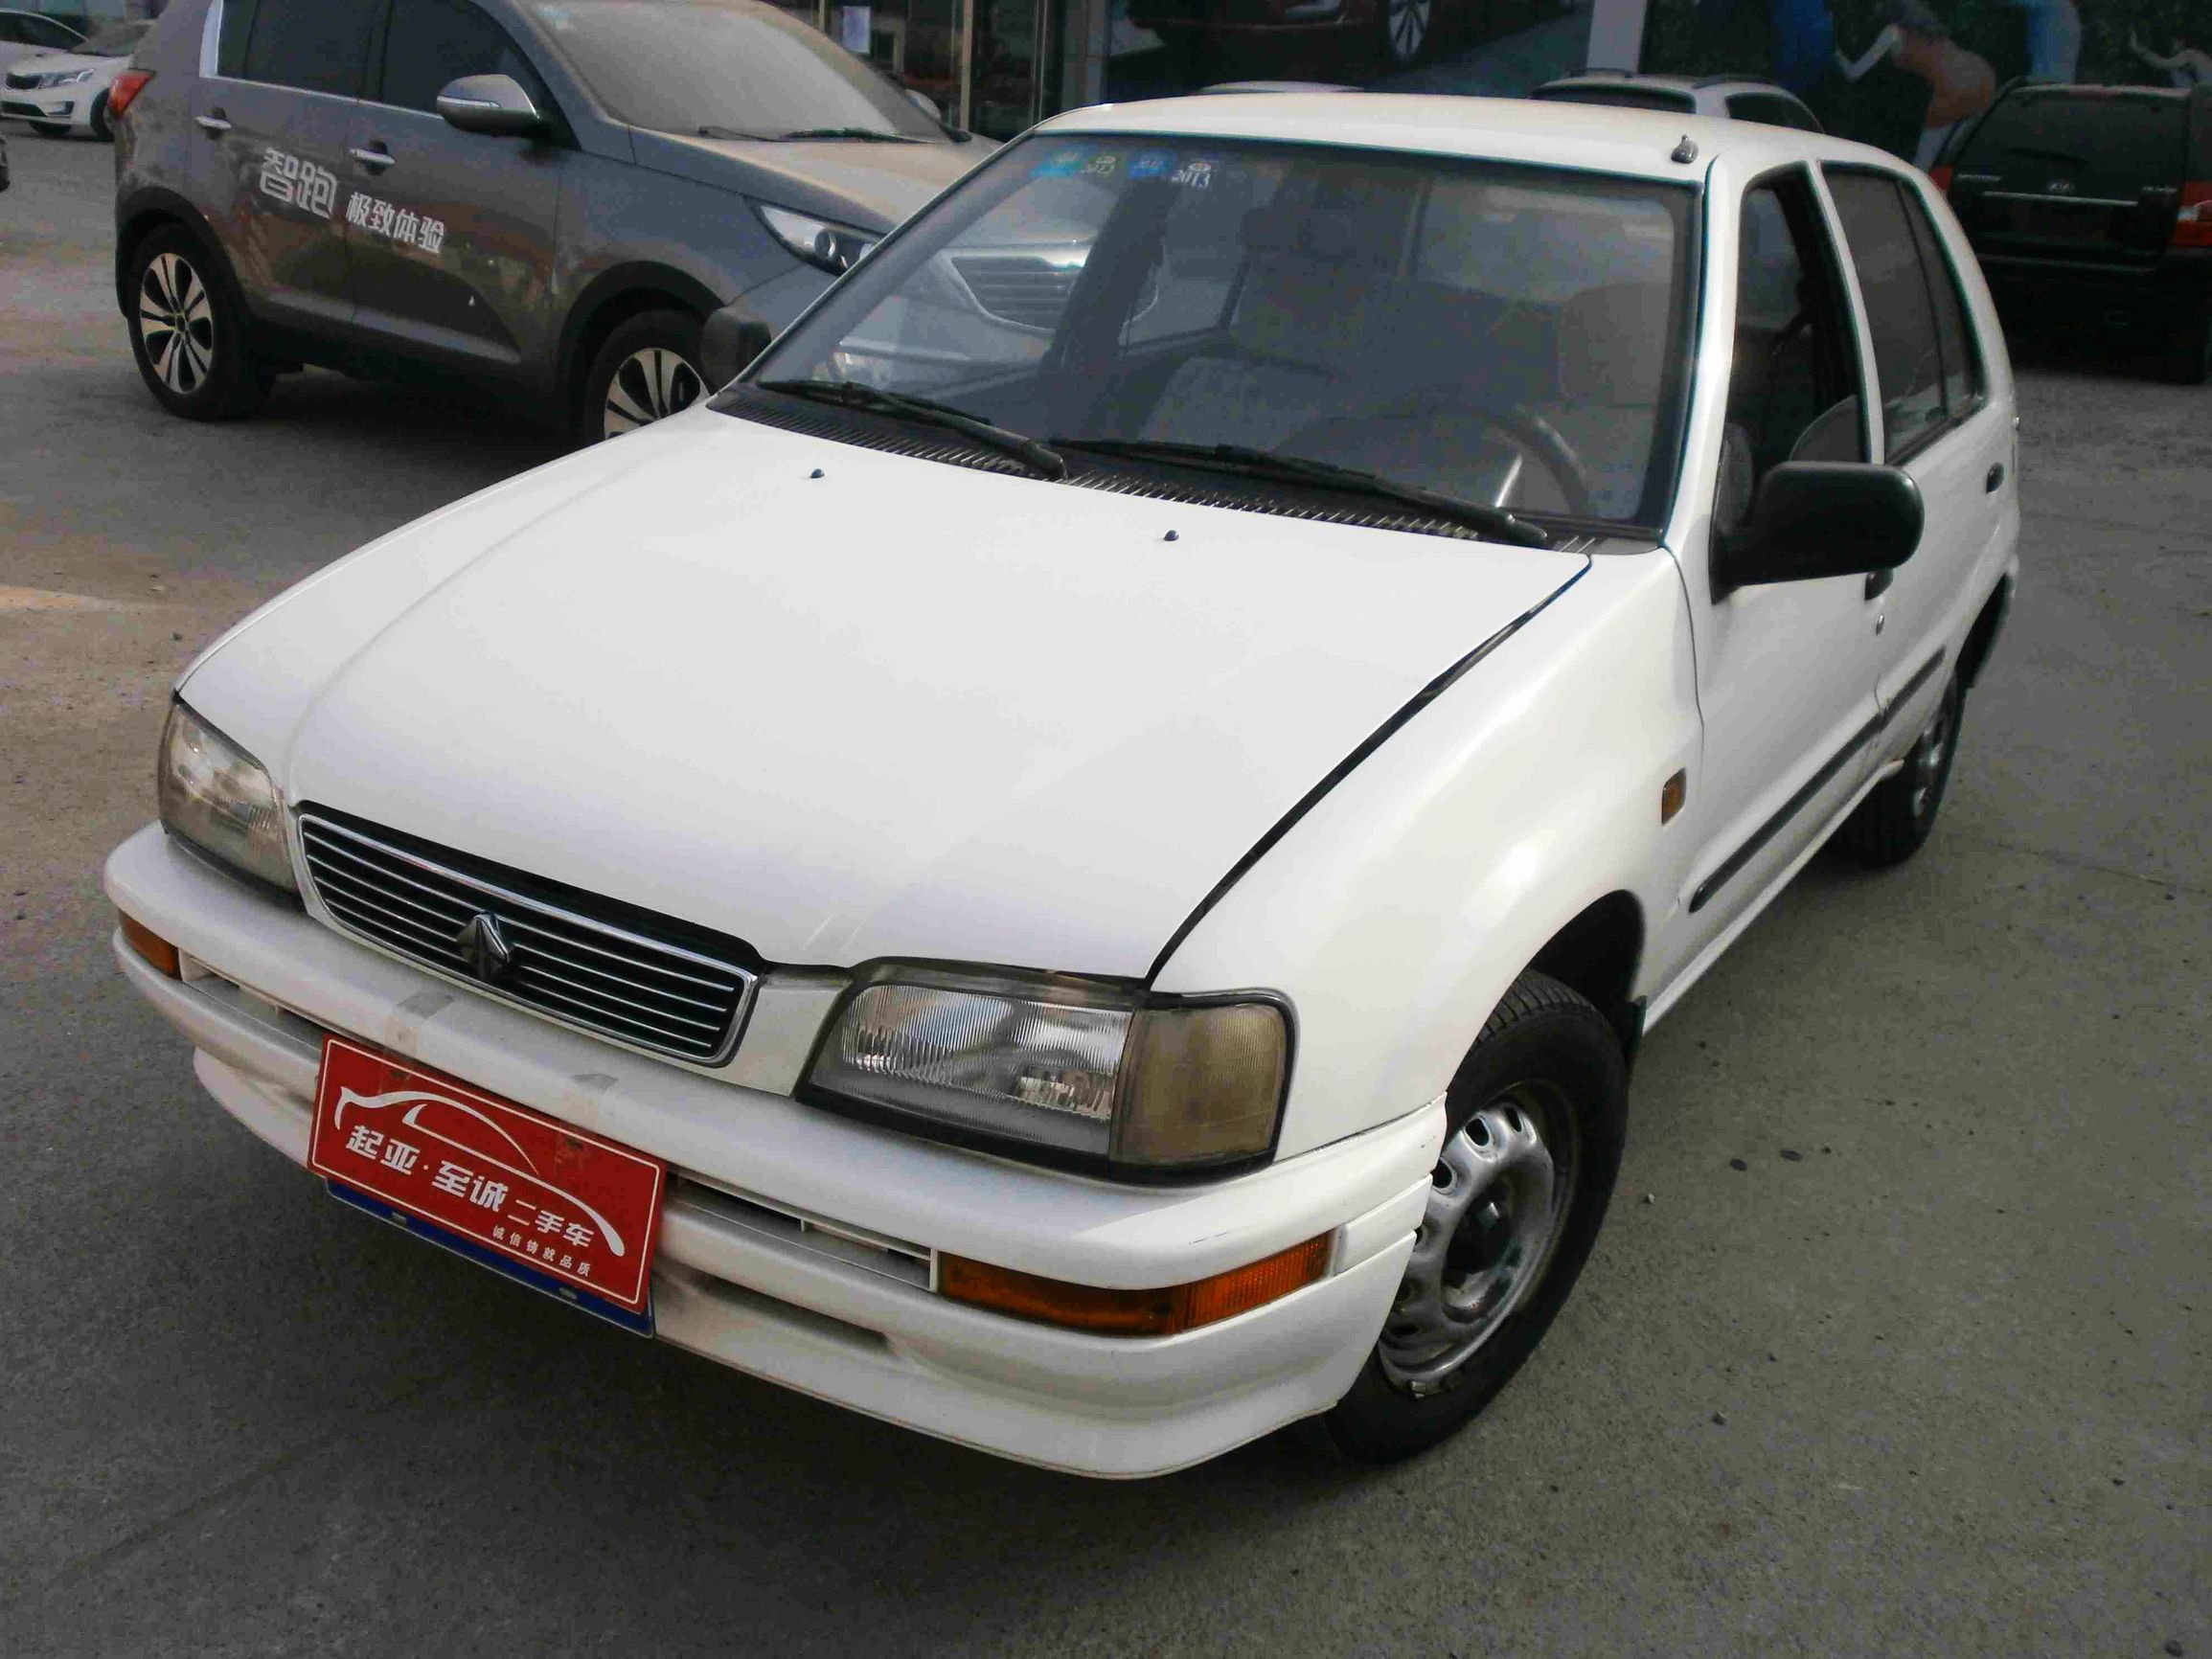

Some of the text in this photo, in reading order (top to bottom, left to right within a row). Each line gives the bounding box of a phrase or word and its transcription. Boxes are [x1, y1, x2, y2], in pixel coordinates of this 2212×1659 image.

[260, 148, 336, 219] 智跑
[346, 192, 445, 253] 极致体验
[491, 1224, 591, 1277] 诚信铸就品质
